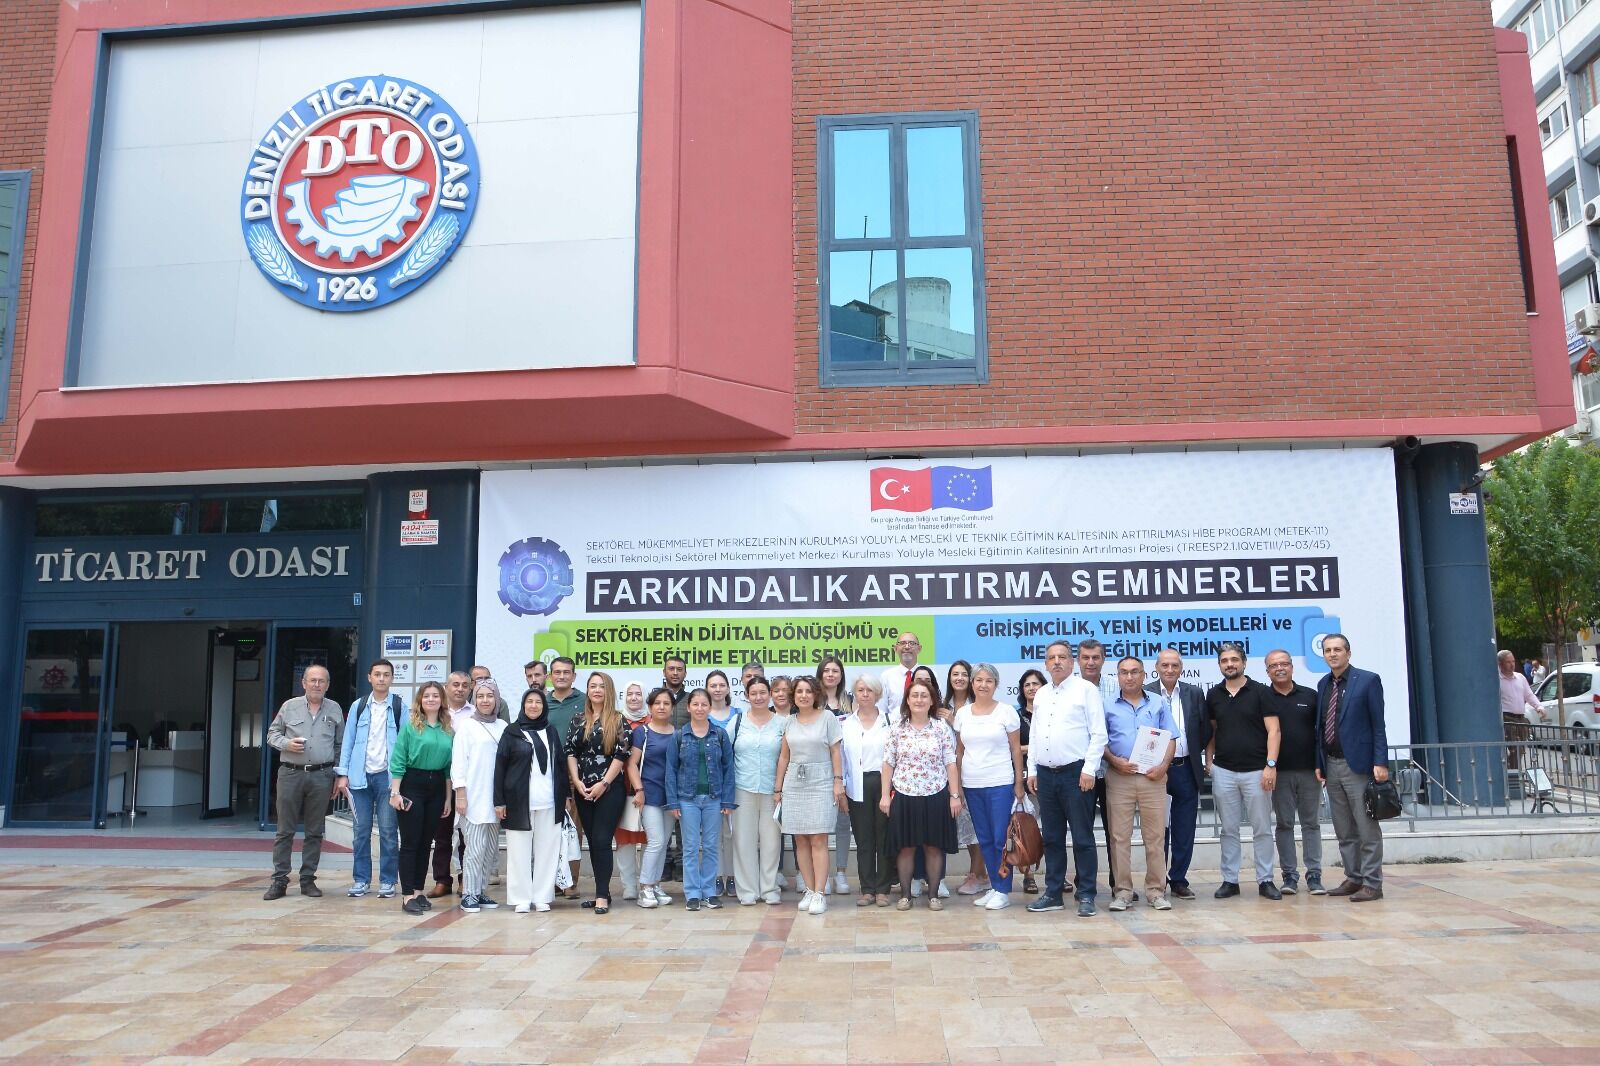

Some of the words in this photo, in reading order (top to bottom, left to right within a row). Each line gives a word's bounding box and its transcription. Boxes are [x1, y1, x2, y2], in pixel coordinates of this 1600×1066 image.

[244, 106, 309, 221] DENİZLİ
[306, 79, 434, 118] TİCARET
[427, 112, 470, 211] ODASI
[300, 117, 424, 177] DTO
[316, 276, 378, 303] 1926
[586, 539, 635, 551] SEKTÖREL
[638, 537, 715, 549] MÜKEMMELİYET
[717, 535, 797, 548] MERKEZLERİNİN
[799, 535, 858, 546] KURULMASI
[860, 535, 907, 545] YOLUYLA
[910, 532, 952, 544] MESLEKİ
[955, 532, 969, 543] VE
[971, 531, 1008, 543] TEKNİK
[1192, 527, 1216, 538] HİBE
[1218, 527, 1271, 538] PROGRAMI
[35, 548, 206, 582] TİCARET
[228, 546, 350, 578] ODASI
[586, 554, 617, 564] Tekstil
[620, 553, 672, 564] Teknolojisi
[675, 552, 717, 562] Sektörel
[720, 551, 796, 562] Mükemmeliyet
[799, 550, 839, 560] Merkezi
[842, 549, 894, 559] Kurulması
[897, 548, 935, 559] Yoluyla
[938, 547, 976, 557] Mesleki
[979, 546, 1023, 557] Eğitimin
[1026, 545, 1079, 555] Kalitesinin
[1139, 543, 1174, 555] Projesi
[593, 574, 849, 606] FARKINDALIK
[859, 571, 1059, 601] ARTTIRMA
[575, 623, 693, 643] SEKTÖRLERİN
[698, 623, 765, 642] DİJİTAL
[769, 621, 873, 643] DÖNÜŞÜMÜ
[877, 626, 899, 640] ve
[976, 617, 1095, 639] GİRİŞİMCİLİK,
[1099, 615, 1141, 635] YENİ
[1146, 615, 1163, 636] İŞ
[1168, 613, 1267, 633] MODELLERİ
[1272, 617, 1293, 631] ve
[575, 647, 647, 666] MESLEKİ
[728, 645, 807, 664] ETKİLERİ
[1103, 638, 1162, 658] EĞİTİM
